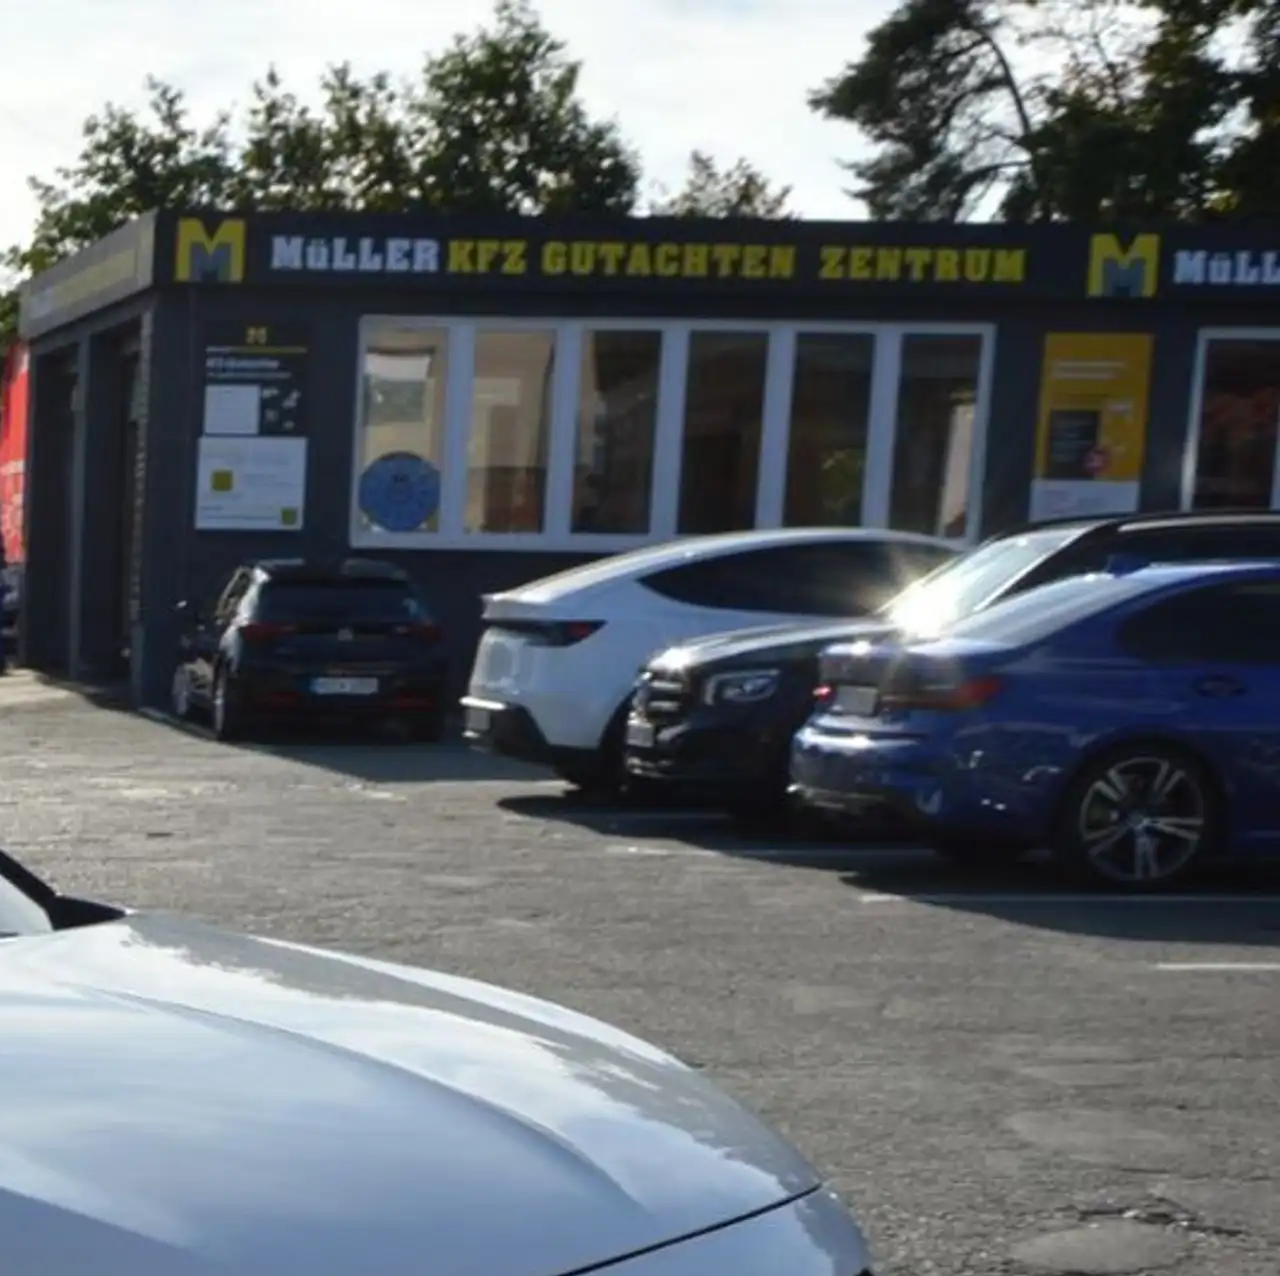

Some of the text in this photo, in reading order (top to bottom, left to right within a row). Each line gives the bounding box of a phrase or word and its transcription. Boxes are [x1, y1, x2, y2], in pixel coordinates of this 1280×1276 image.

[447, 239, 527, 275] KFZ
[541, 240, 797, 278] GUTACHTEN
[819, 245, 1027, 282] ZENTRUM
